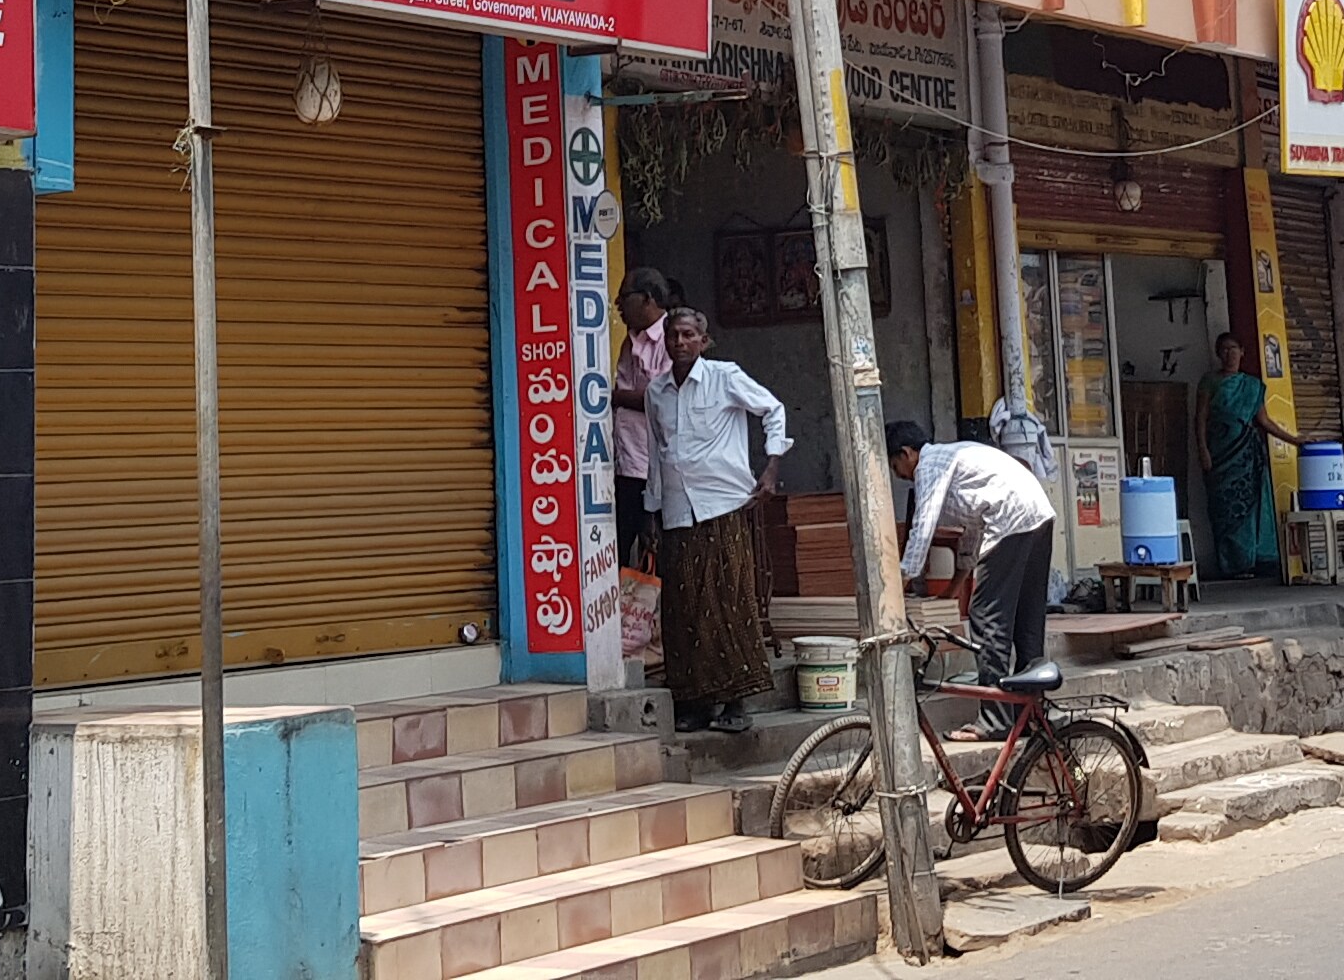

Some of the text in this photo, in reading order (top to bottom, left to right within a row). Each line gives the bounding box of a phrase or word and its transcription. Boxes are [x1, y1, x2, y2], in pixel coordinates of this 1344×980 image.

[540, 6, 616, 33] VIJAYAWADA-2
[888, 68, 957, 111] CENTRE
[516, 52, 560, 333] MEDICAL
[521, 343, 567, 362] SHOP
[571, 195, 612, 516] MEDICAL
[589, 524, 602, 544] &
[583, 540, 617, 589] FANCY
[586, 585, 619, 633] SHOP
